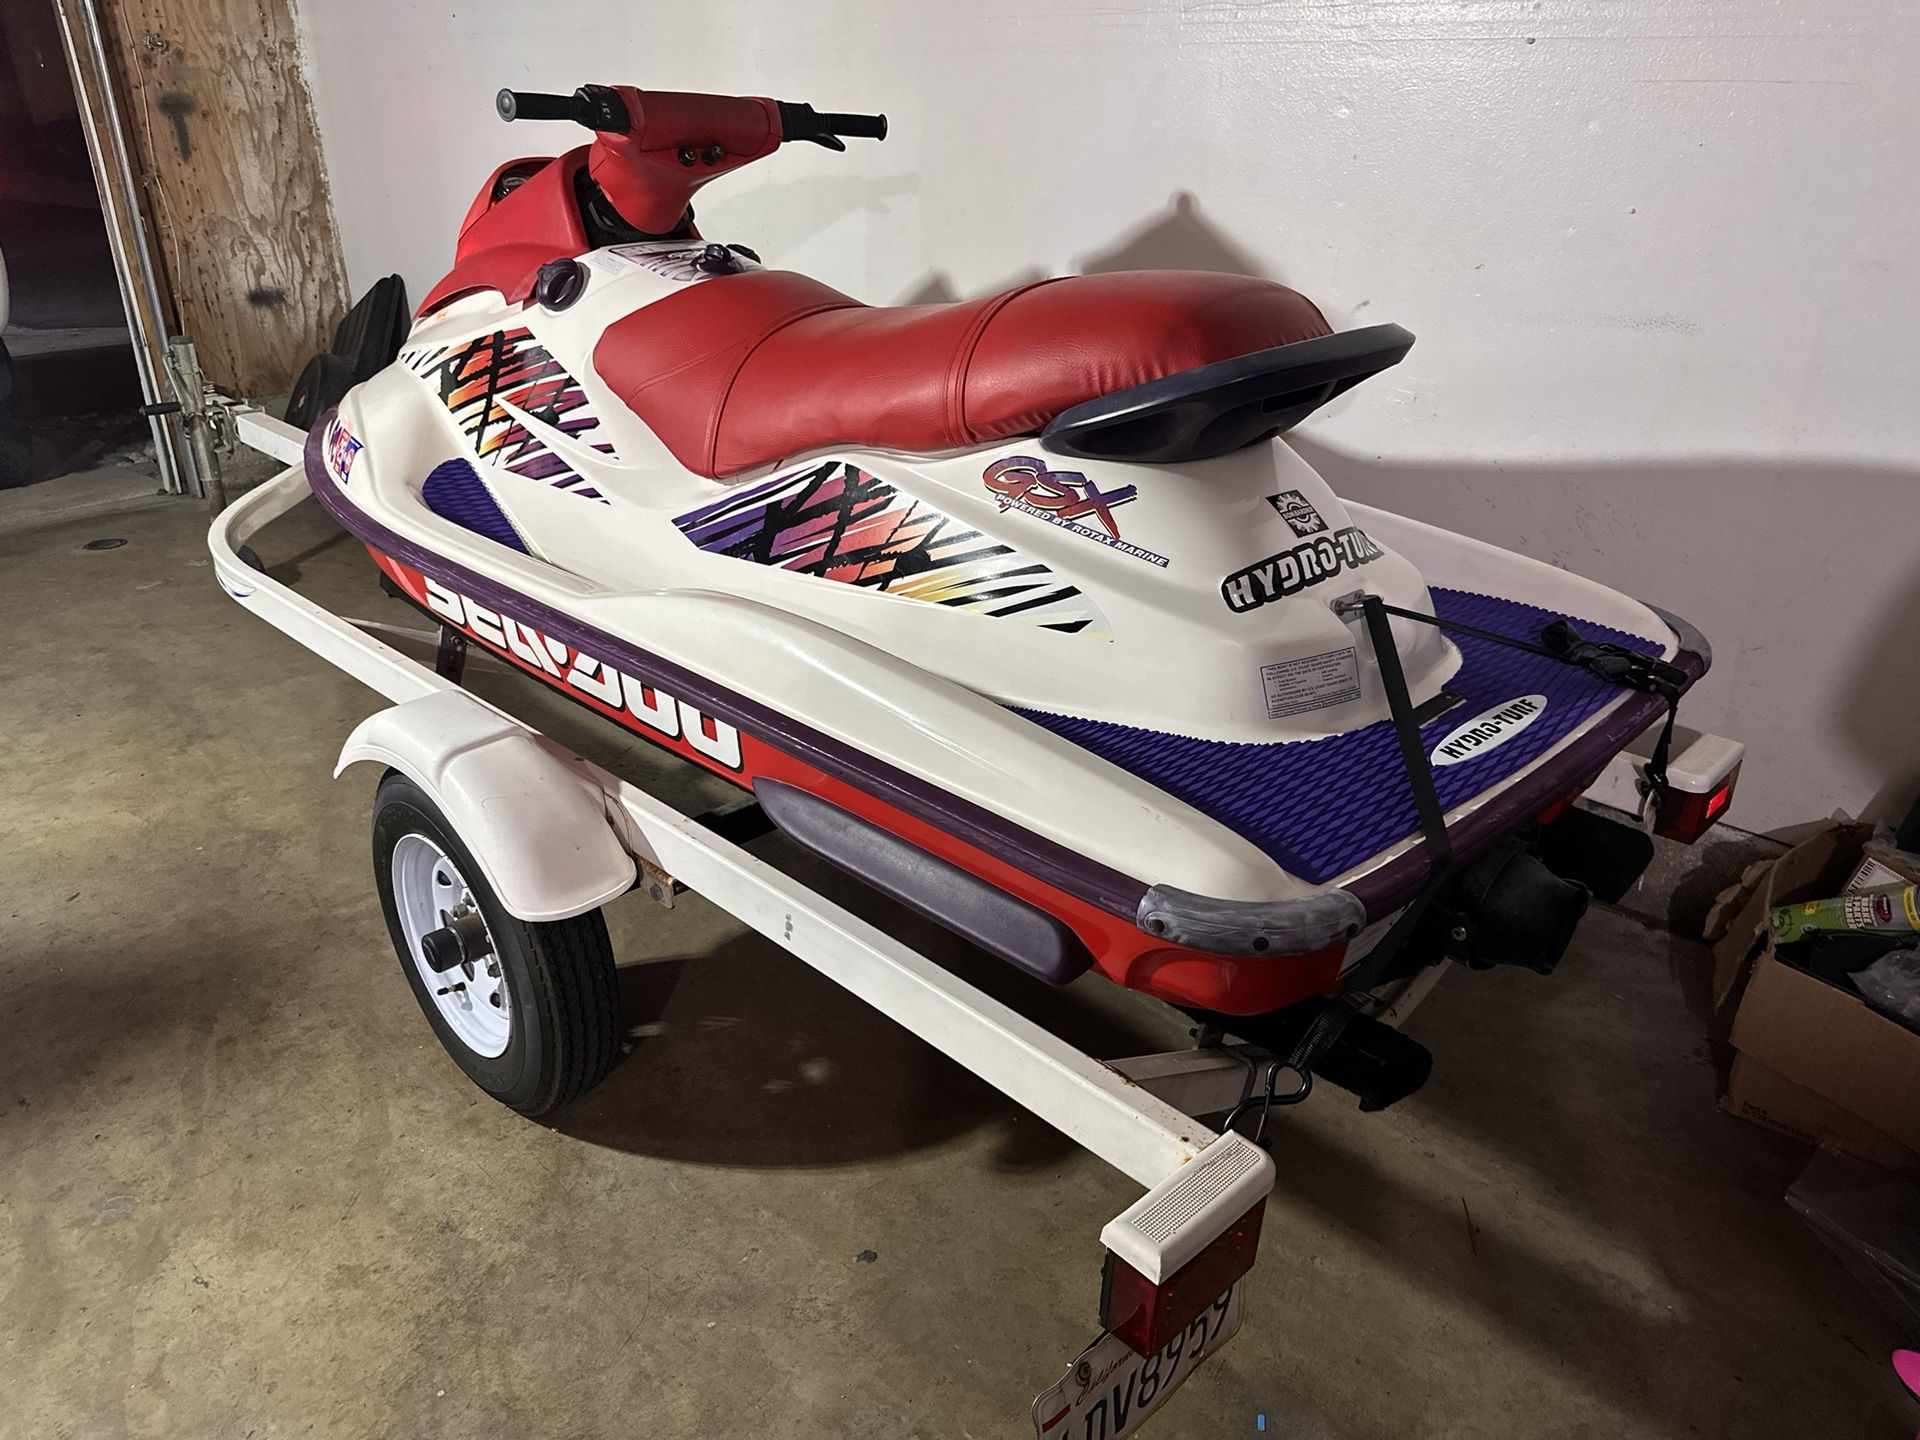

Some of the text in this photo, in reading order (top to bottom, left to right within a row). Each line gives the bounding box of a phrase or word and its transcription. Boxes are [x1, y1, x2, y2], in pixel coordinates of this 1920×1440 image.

[983, 456, 1137, 541] GSX
[996, 493, 1168, 567] POWERED BY ROTAX MARINE
[1439, 698, 1539, 760] HYDRO-TURF
[1062, 1284, 1233, 1440] DV8959
